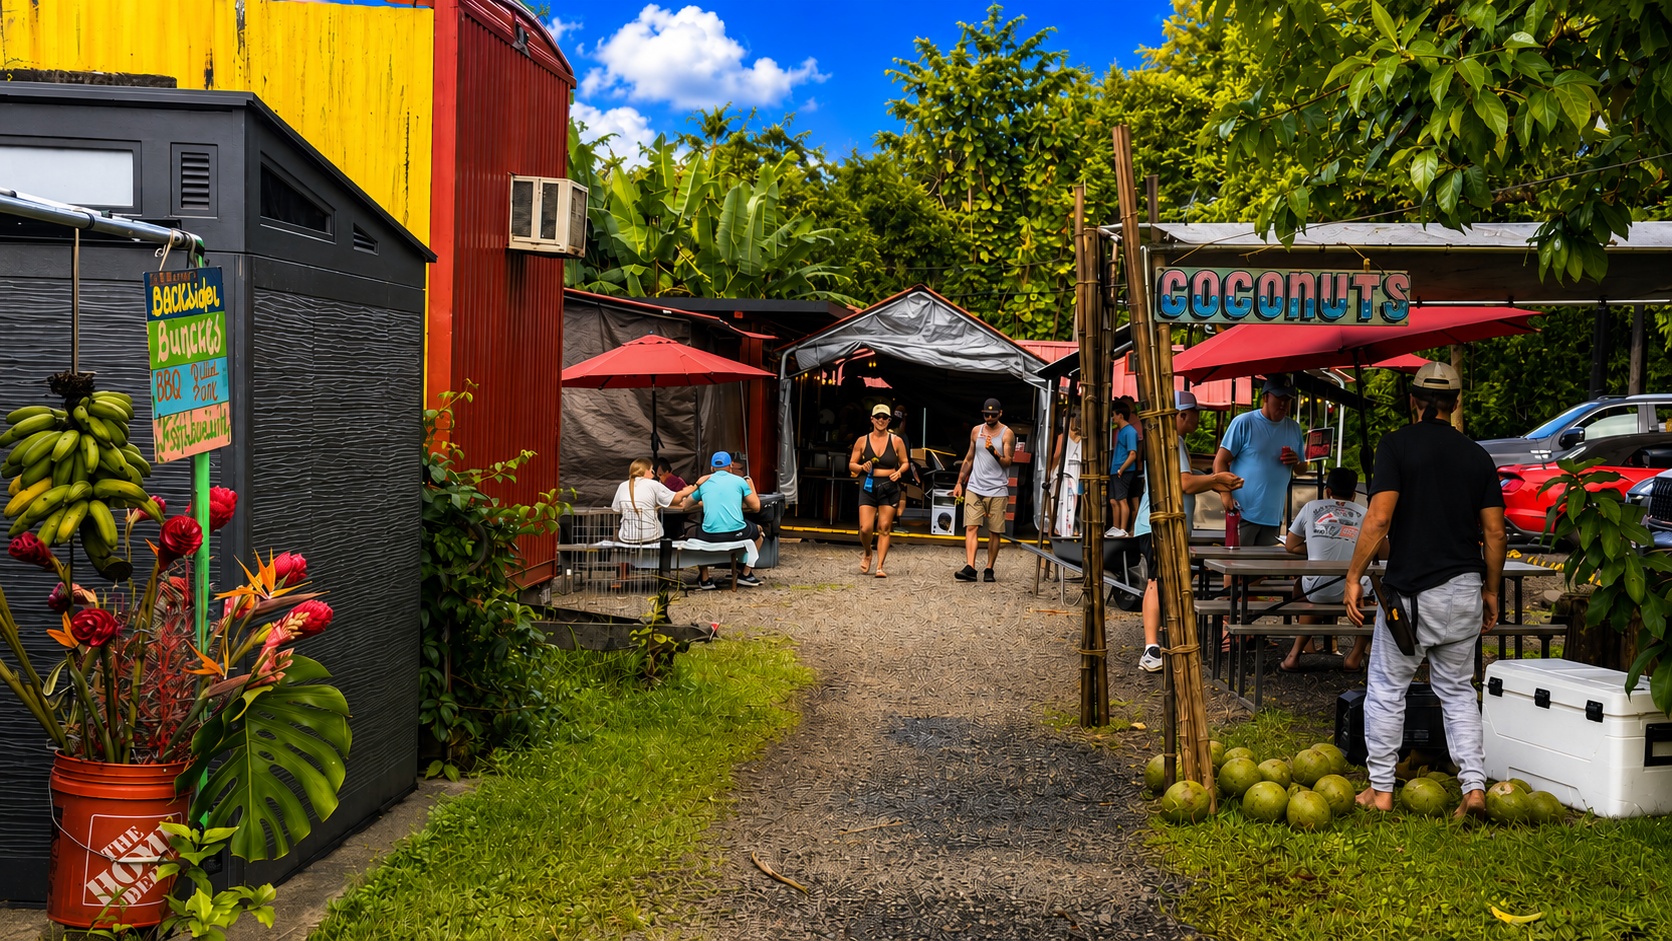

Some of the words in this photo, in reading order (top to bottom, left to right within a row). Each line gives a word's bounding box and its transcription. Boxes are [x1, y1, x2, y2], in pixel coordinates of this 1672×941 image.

[1157, 269, 1411, 322] COCONUTS
[156, 368, 182, 402] BBQ
[100, 825, 144, 859] THE
[86, 826, 174, 905] HOM
